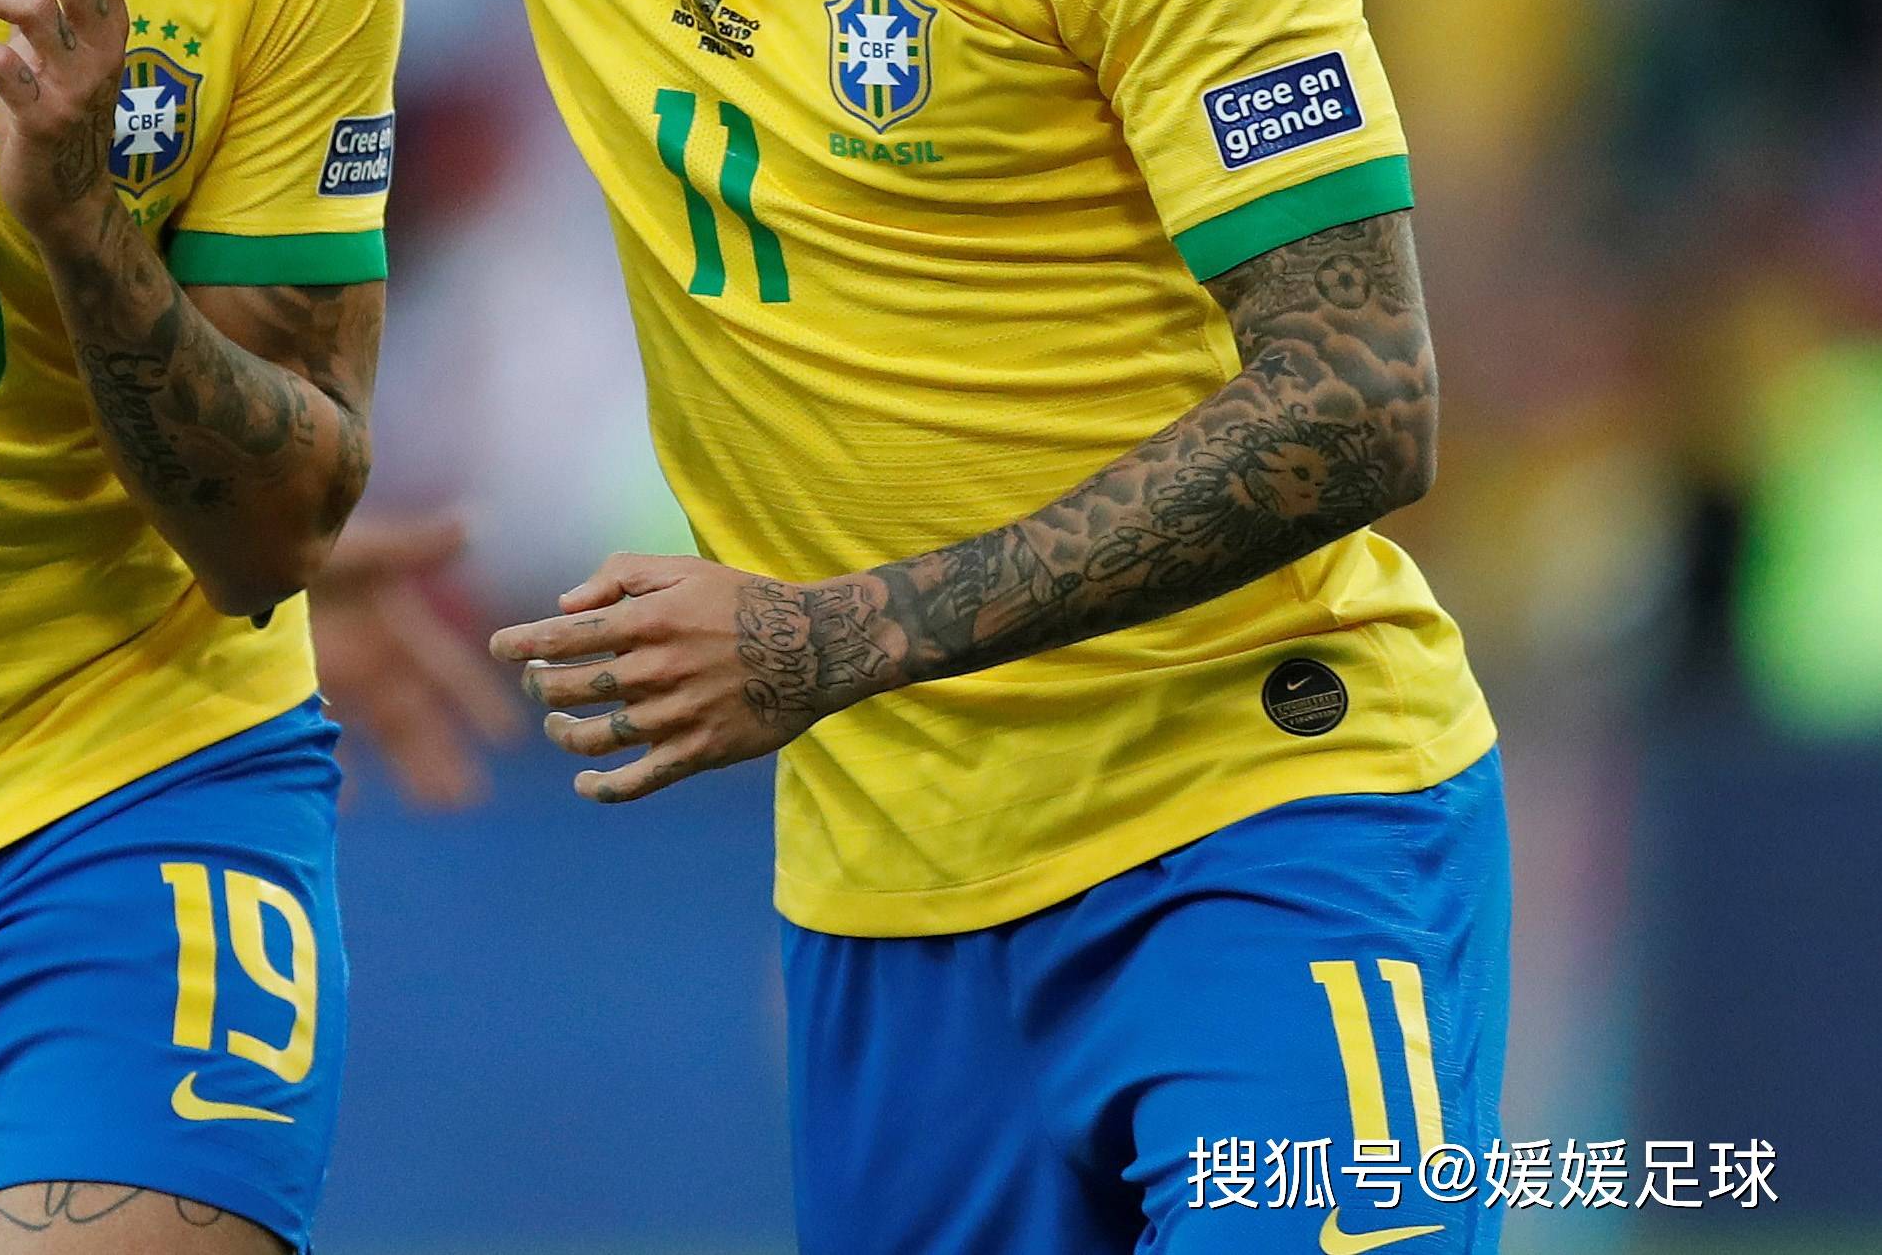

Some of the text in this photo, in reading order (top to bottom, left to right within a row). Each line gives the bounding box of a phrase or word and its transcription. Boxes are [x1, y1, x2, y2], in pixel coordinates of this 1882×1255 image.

[859, 40, 895, 60] CBF
[1215, 67, 1341, 123] Cree en
[128, 112, 165, 132] CBF
[335, 126, 378, 154] Cree
[829, 132, 943, 166] BRASIL
[324, 151, 388, 189] grande
[653, 88, 790, 303] 11
[160, 862, 317, 1085] 19
[1309, 958, 1446, 1166] 11
